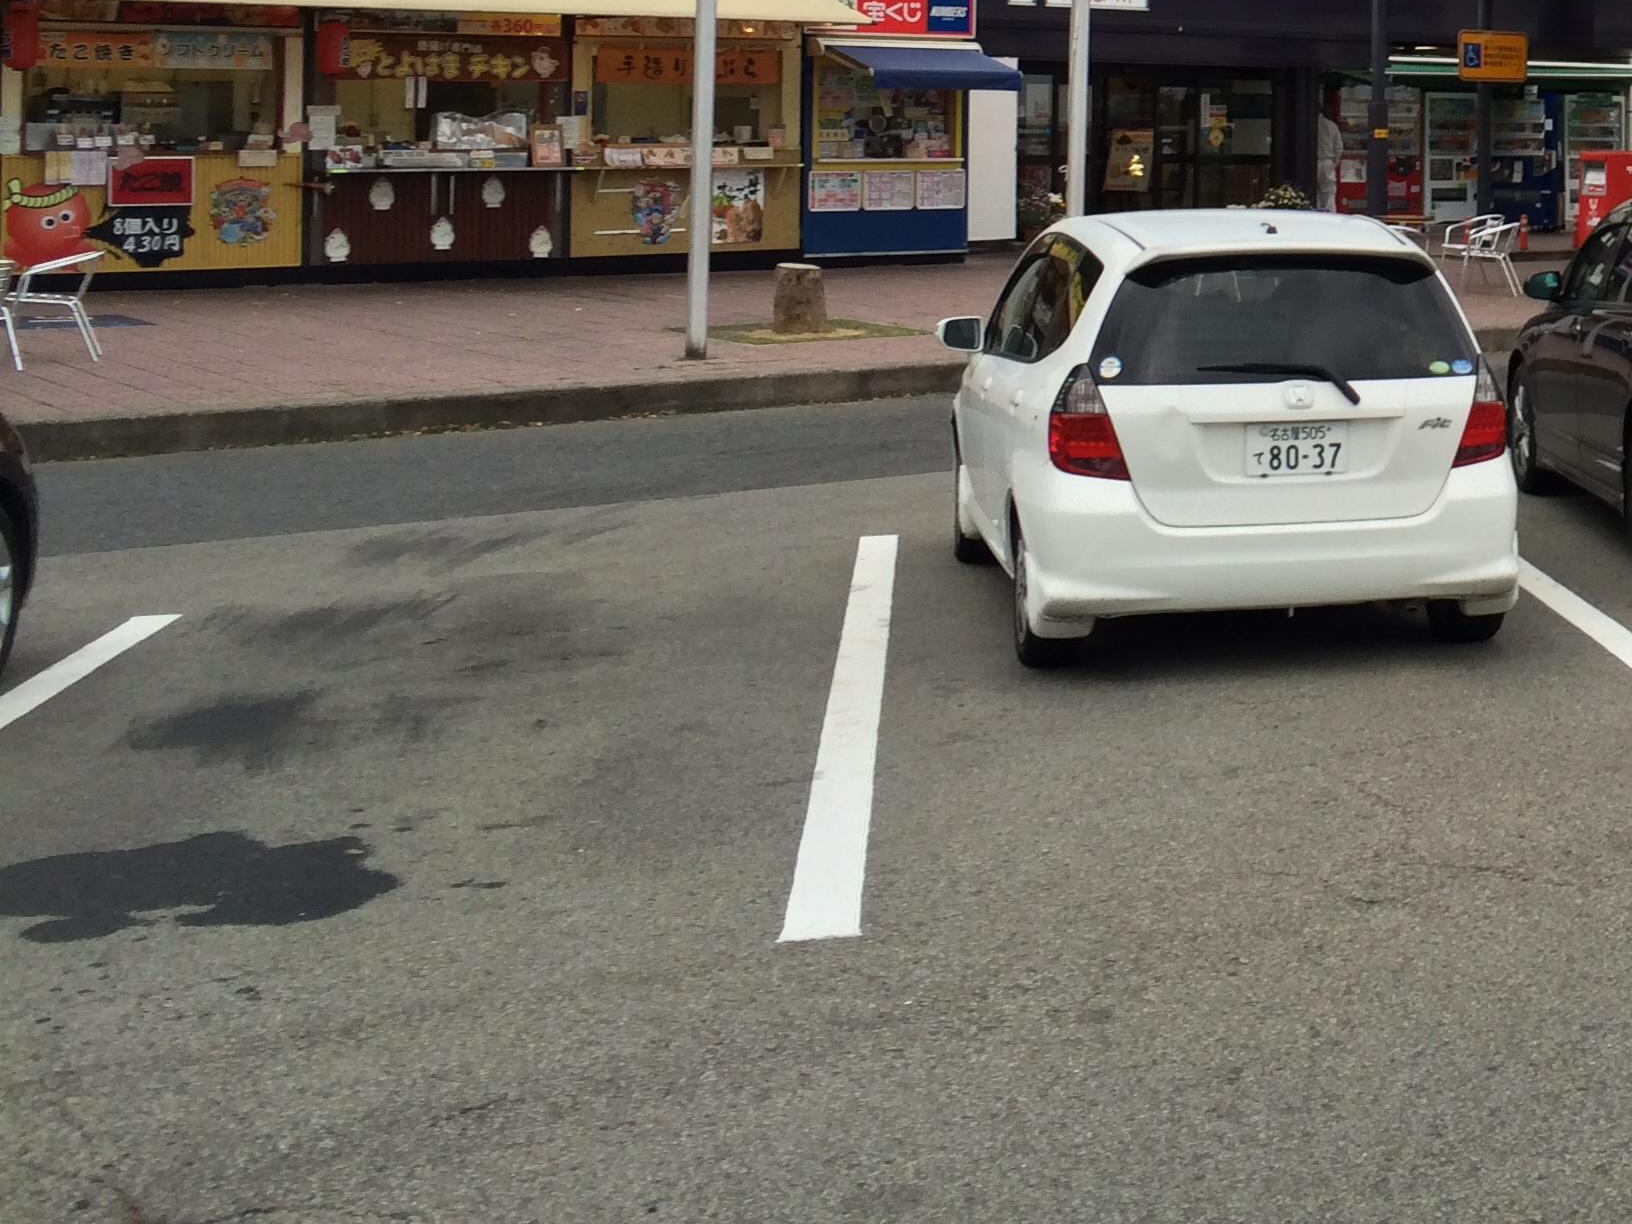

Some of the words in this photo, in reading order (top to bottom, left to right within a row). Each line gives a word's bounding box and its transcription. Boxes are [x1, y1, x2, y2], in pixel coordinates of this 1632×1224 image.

[862, 0, 922, 22] 宝くじ
[49, 43, 135, 62] たこ焼き
[160, 43, 265, 59] ソフトクリーム
[112, 217, 179, 235] 8個入り
[122, 236, 181, 252] 430円
[1269, 443, 1342, 470] 80-37
